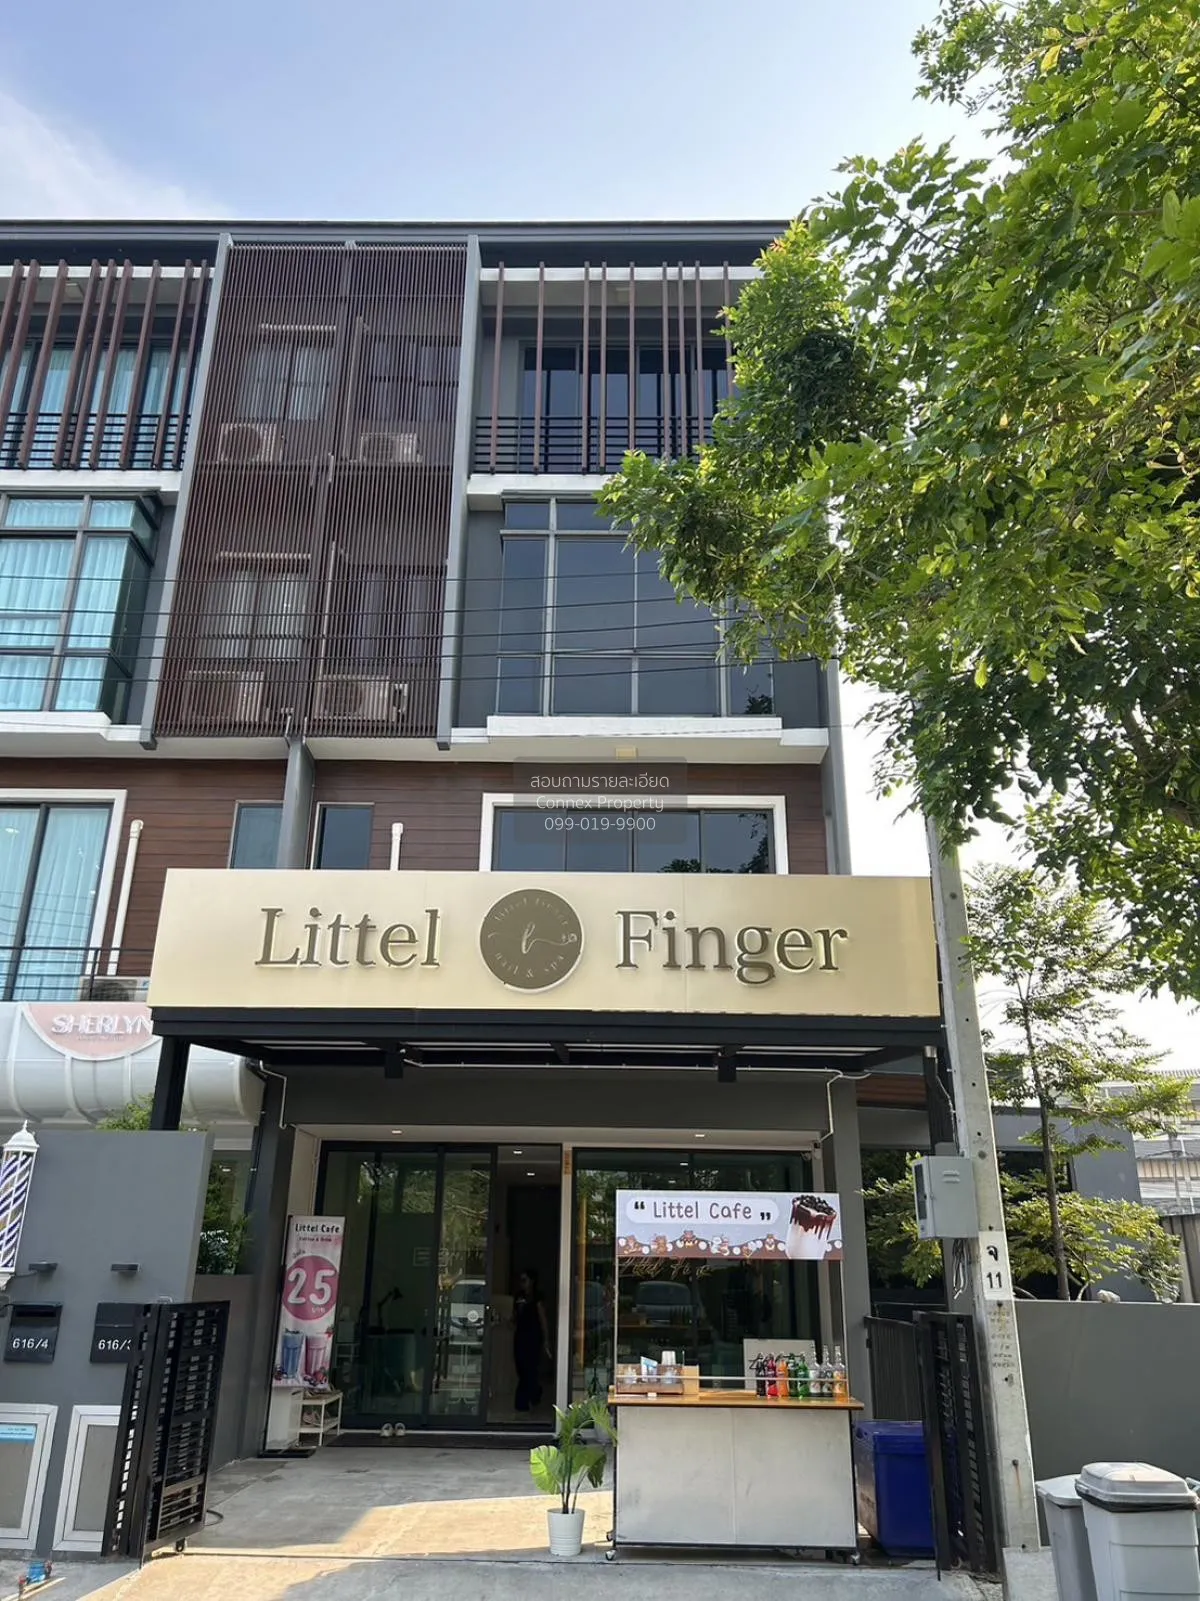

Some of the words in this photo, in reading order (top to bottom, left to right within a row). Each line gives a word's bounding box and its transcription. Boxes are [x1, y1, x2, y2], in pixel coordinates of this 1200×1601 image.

[254, 907, 441, 967] Littel
[615, 910, 850, 985] Finger
[320, 1224, 340, 1233] Cafe
[287, 1267, 336, 1305] 25
[986, 1271, 1003, 1289] 11
[12, 1337, 49, 1350] 616/4
